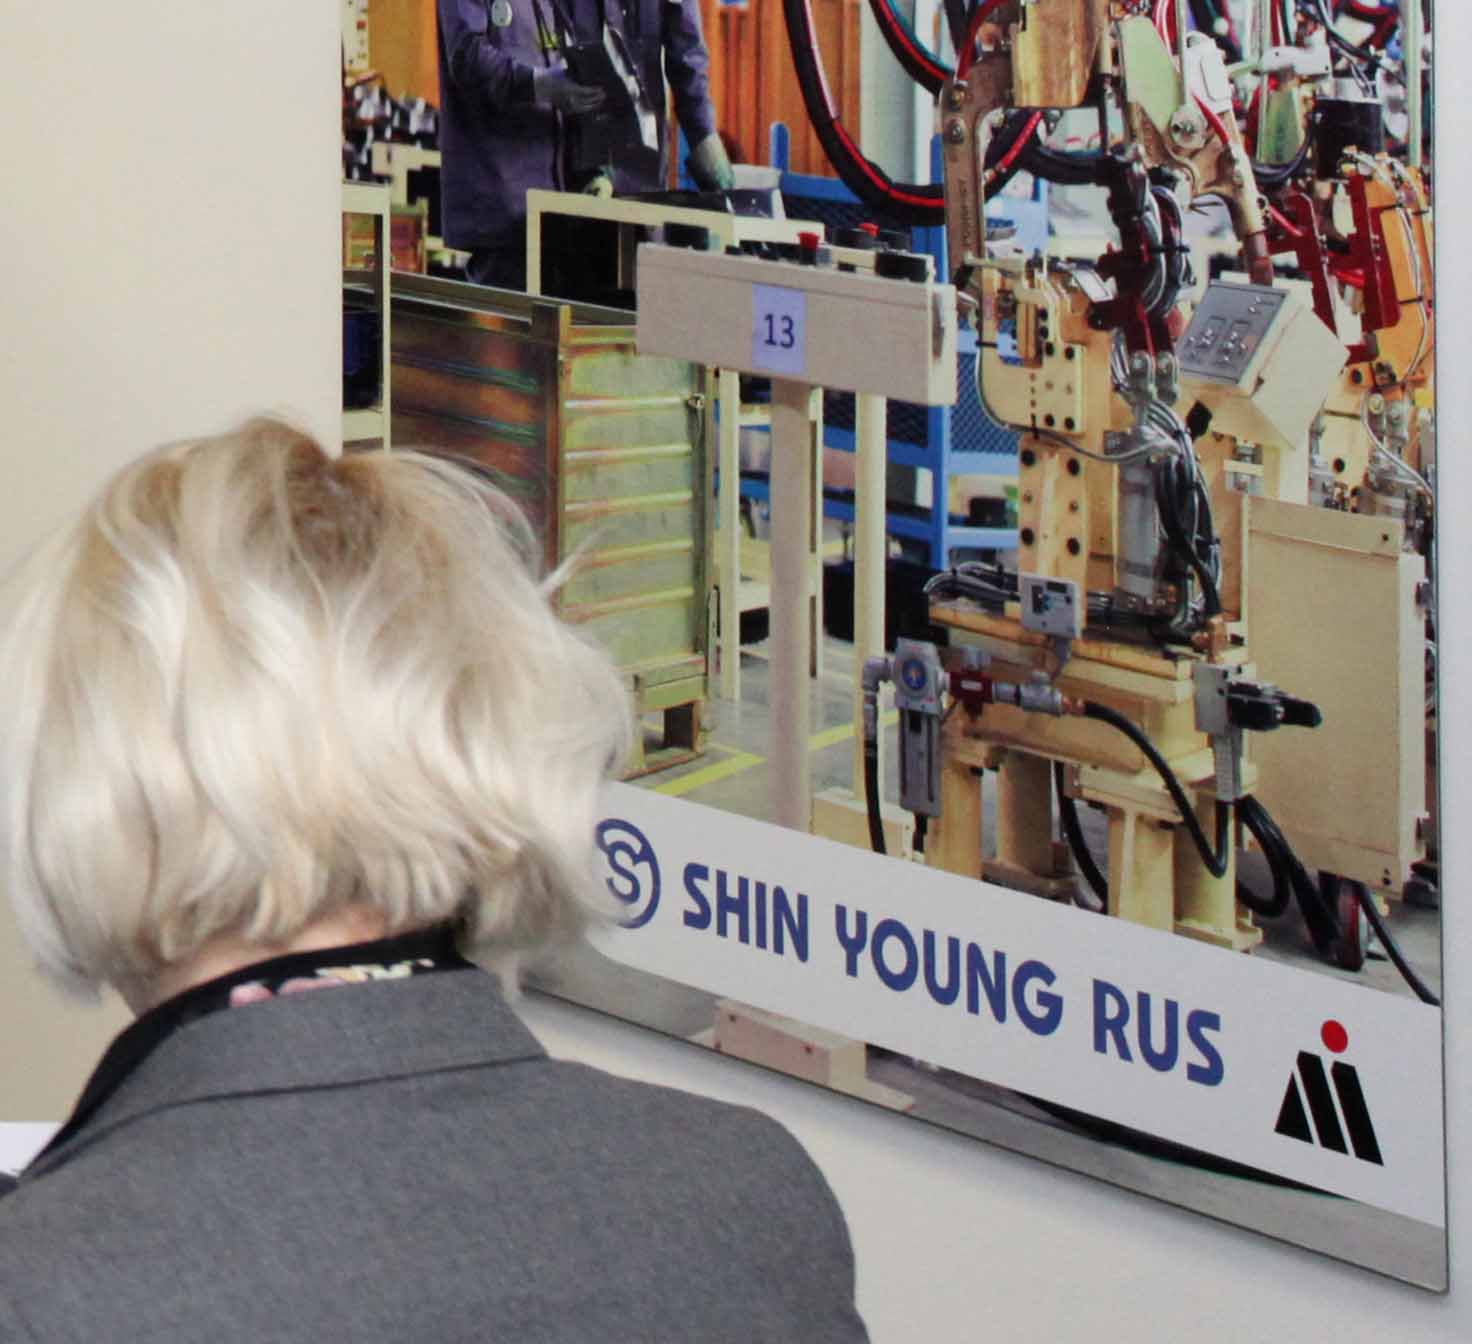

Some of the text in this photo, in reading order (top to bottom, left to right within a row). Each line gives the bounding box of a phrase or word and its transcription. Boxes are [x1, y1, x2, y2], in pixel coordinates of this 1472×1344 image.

[762, 312, 795, 349] 13
[683, 862, 809, 963] SHIN
[835, 904, 1063, 1036] YOUNG
[1093, 977, 1224, 1087] RUS
